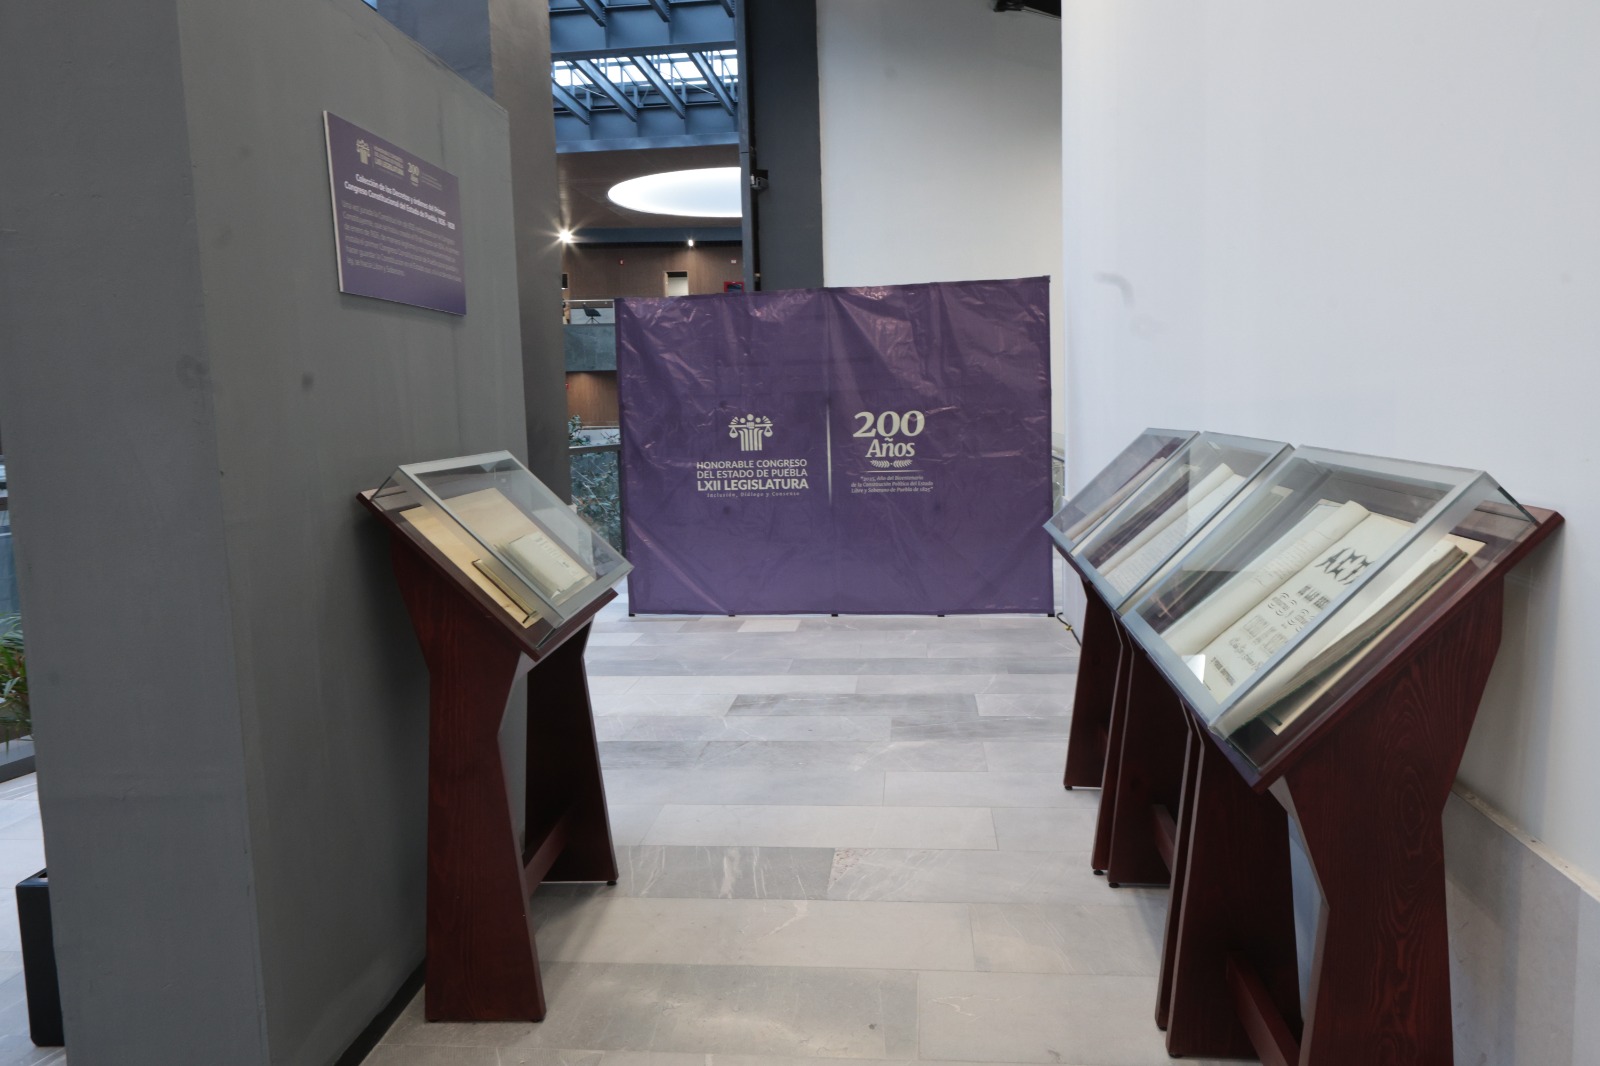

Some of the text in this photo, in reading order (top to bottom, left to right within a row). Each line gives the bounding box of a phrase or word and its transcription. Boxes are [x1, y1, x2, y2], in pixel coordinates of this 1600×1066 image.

[344, 181, 368, 196] Congreso
[368, 190, 399, 207] Constitucional
[853, 410, 925, 438] 200
[865, 437, 916, 458] Años
[696, 458, 808, 470] HONORABLE CONGRESO
[696, 468, 808, 479] DEL ESTADO DE PUEBLA
[697, 478, 809, 491] LXII LEGISLATURA
[1314, 548, 1376, 586] ACT
